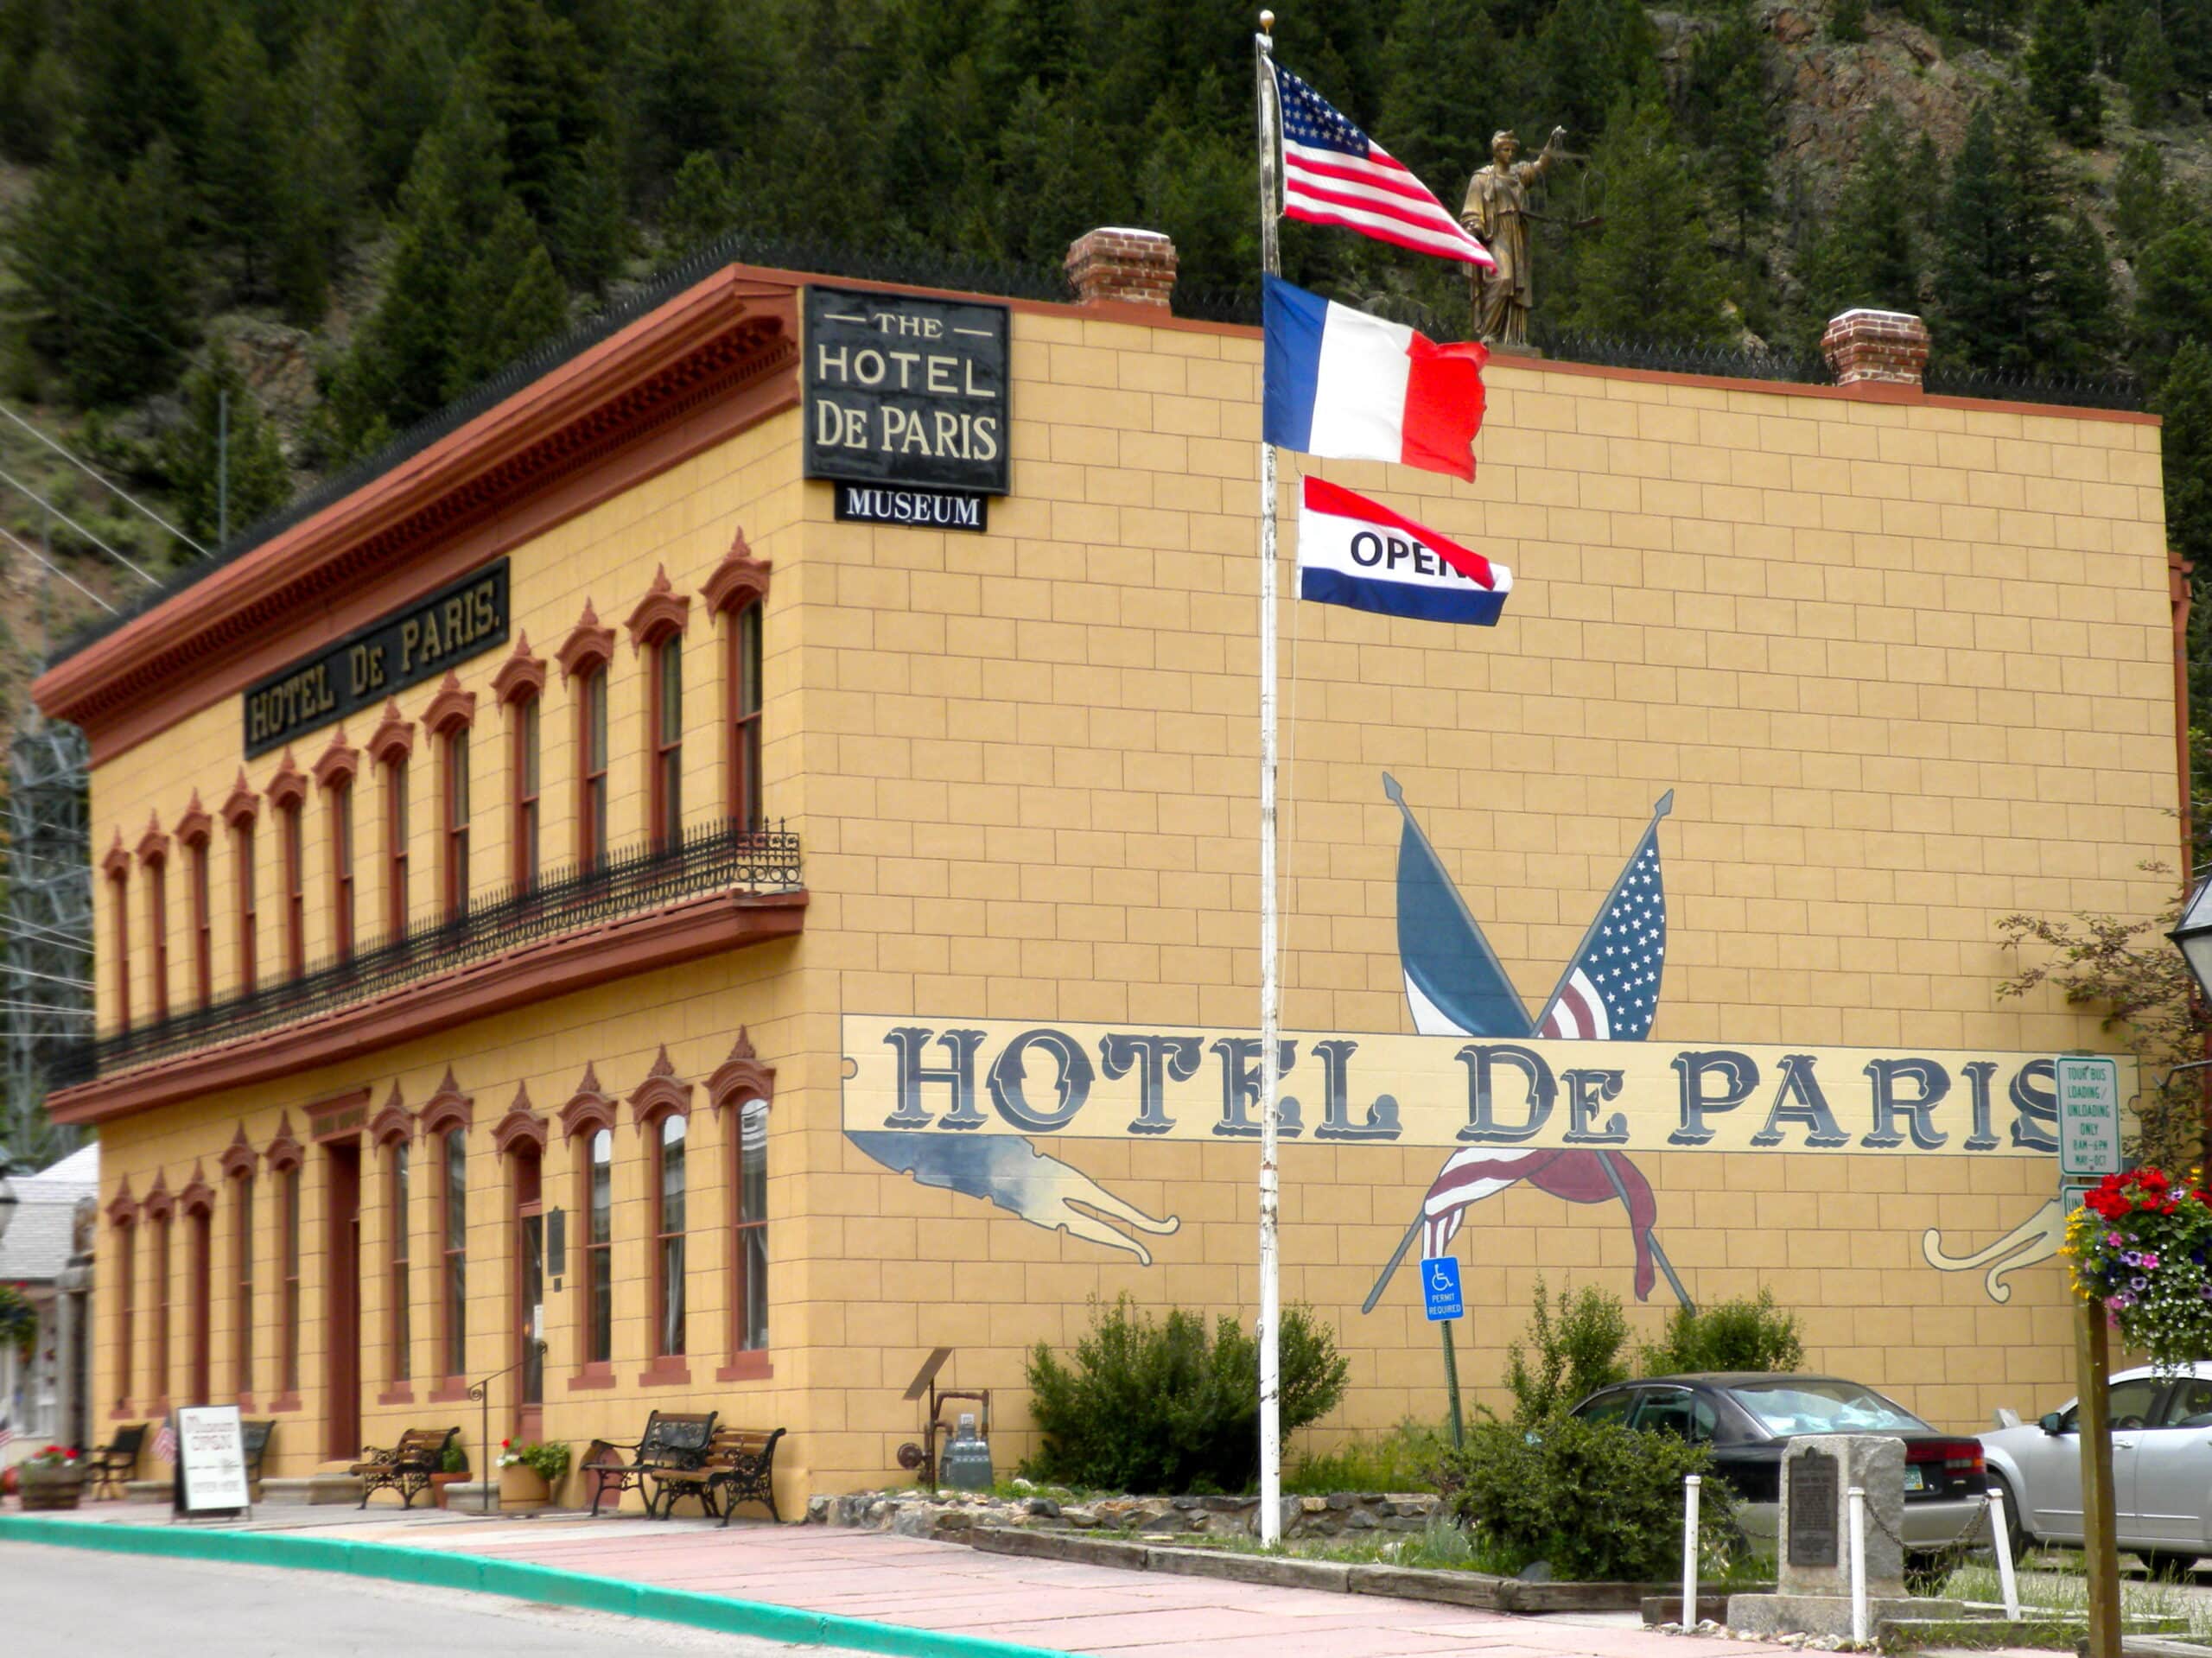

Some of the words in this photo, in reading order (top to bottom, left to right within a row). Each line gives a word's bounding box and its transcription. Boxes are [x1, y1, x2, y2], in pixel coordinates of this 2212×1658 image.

[874, 313, 944, 338] THE
[817, 343, 995, 397] HOTEL
[817, 399, 868, 448] DE
[880, 406, 997, 461] PARIS
[847, 487, 980, 525] MUSEUM
[250, 664, 334, 742] HOTEL
[349, 644, 385, 695] DE
[883, 1026, 1402, 1140] HOTEL
[1453, 1045, 1630, 1145] DE
[2067, 1066, 2087, 1080] TOUR
[2090, 1068, 2107, 1081] BUS
[2067, 1104, 2110, 1118] UNLOADING
[2080, 1122, 2099, 1135] ONLY
[1428, 1304, 1462, 1315] REQUIRED
[1432, 1293, 1455, 1303] PERMIT
